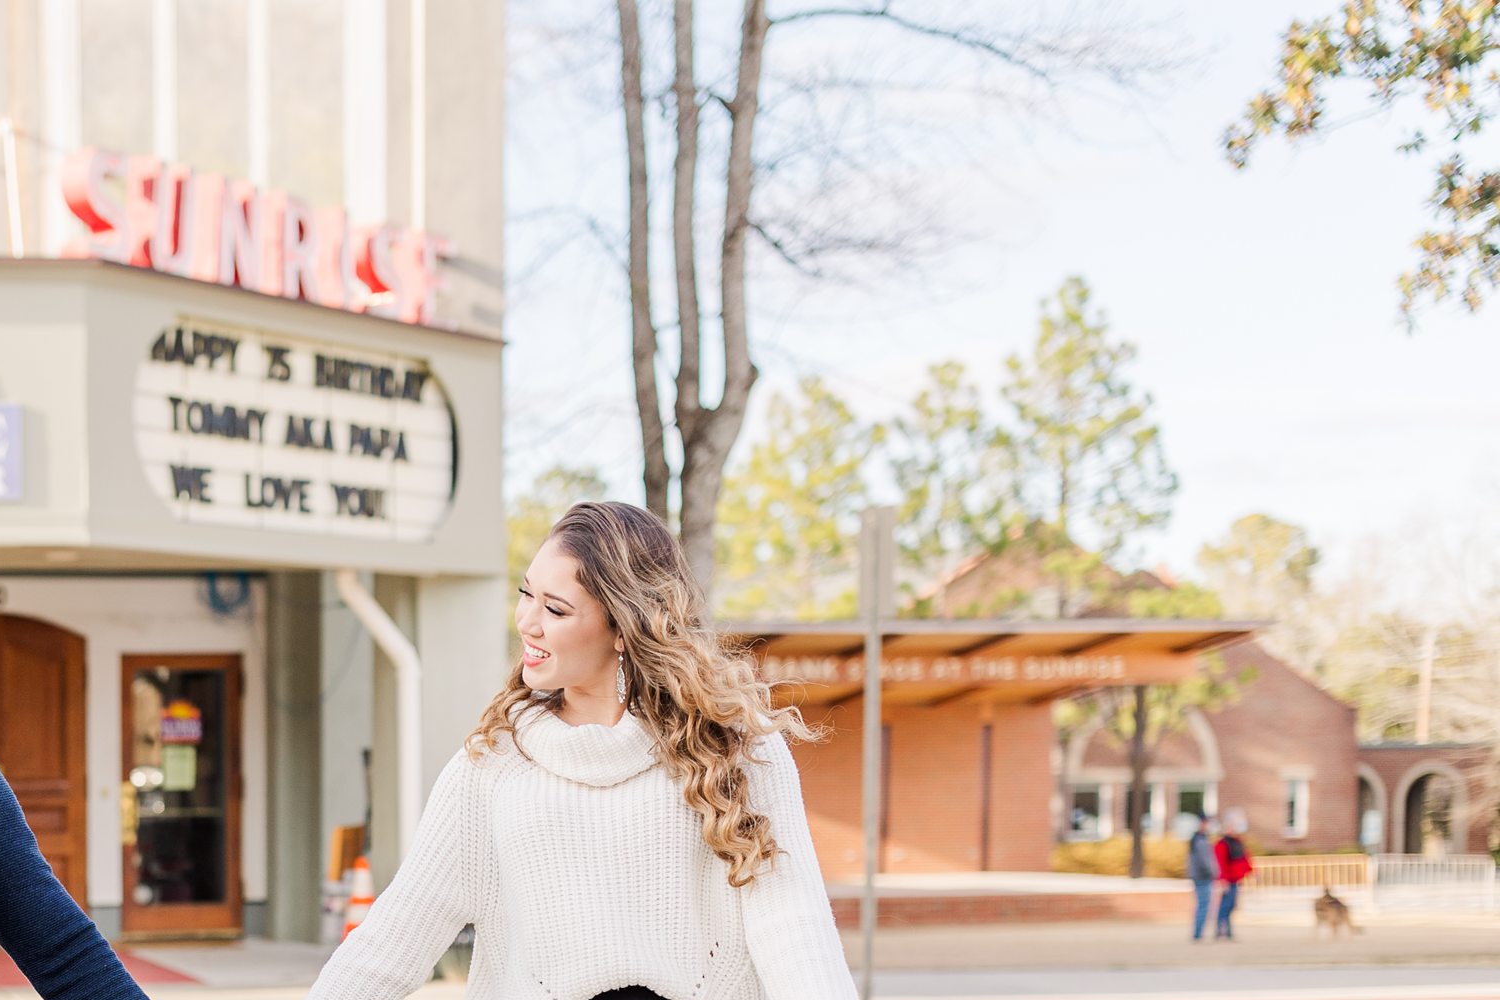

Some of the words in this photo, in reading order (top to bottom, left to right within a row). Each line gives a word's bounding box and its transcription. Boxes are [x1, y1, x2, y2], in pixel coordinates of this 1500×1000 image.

[61, 147, 457, 330] SUNRISE
[315, 354, 431, 402] BIRTHDAY
[168, 396, 268, 443] TOMMY
[284, 415, 334, 450] AKA
[349, 423, 408, 462] PAPA
[169, 465, 212, 503] WE
[245, 473, 313, 512] LOVE
